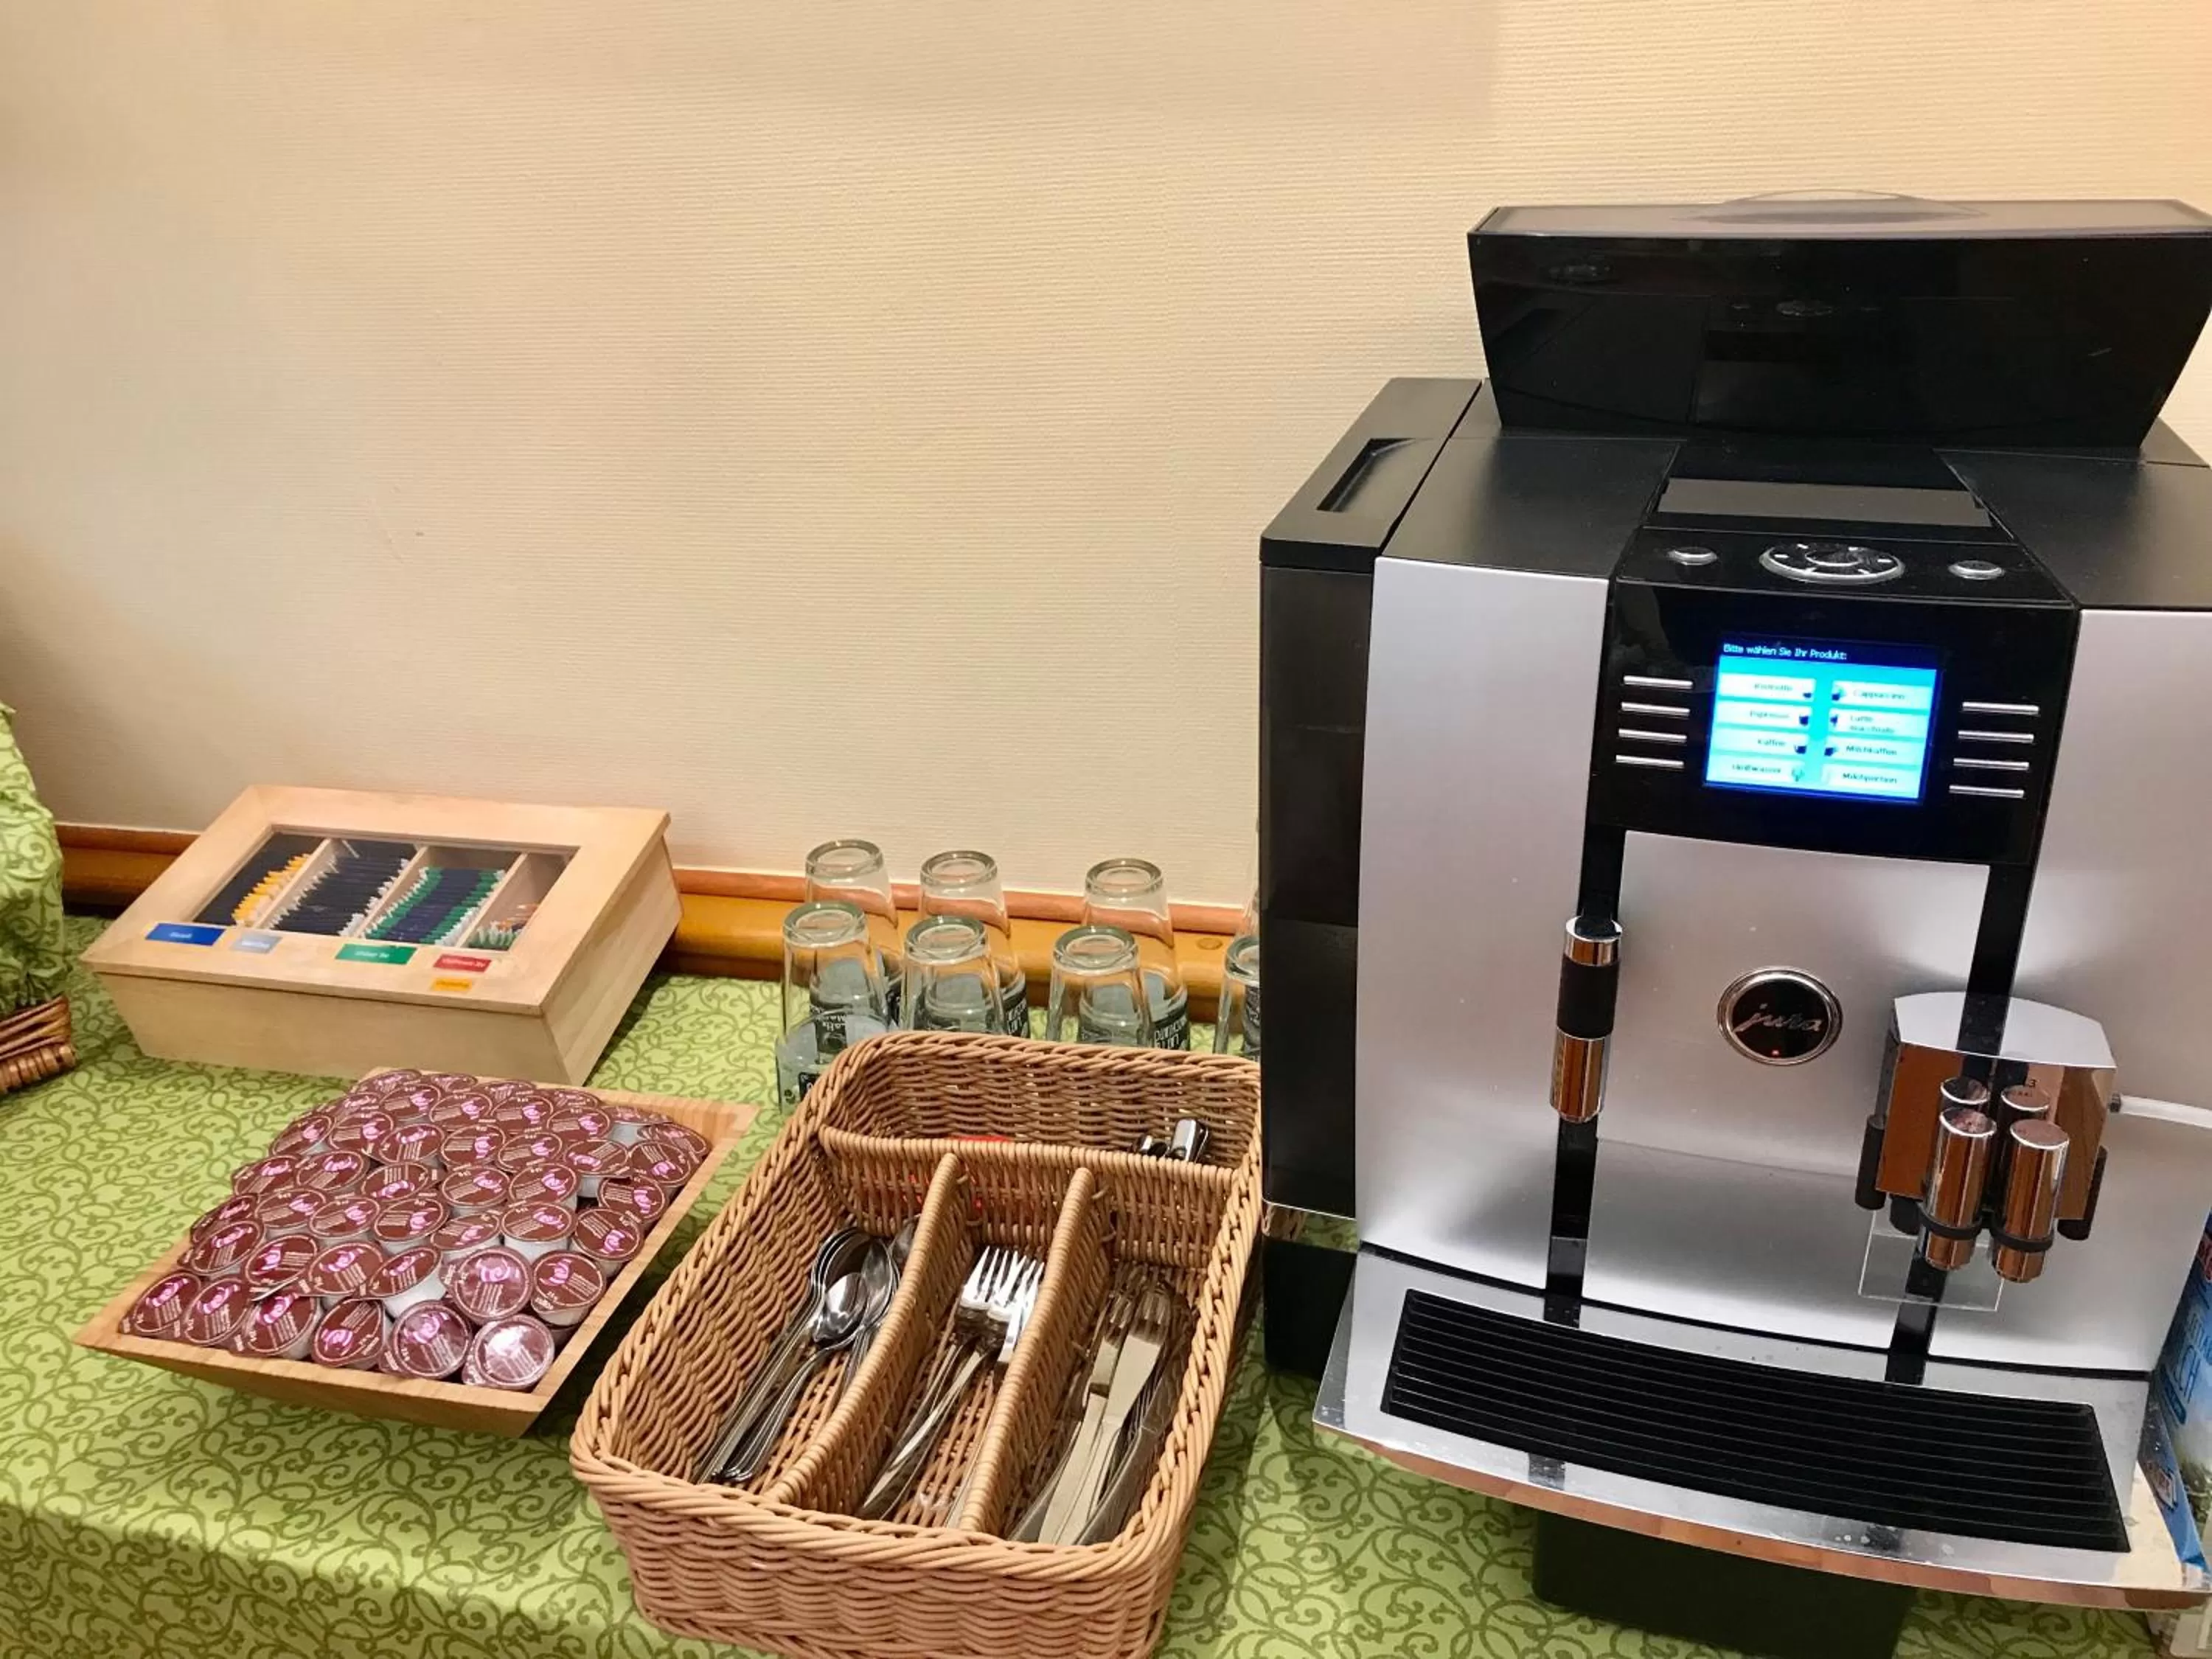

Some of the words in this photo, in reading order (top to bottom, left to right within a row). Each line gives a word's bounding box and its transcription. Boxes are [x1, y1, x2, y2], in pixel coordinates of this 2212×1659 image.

[1723, 643, 1744, 653] Bitte
[1778, 647, 1792, 656] Sie
[1794, 648, 1807, 657] Ihr
